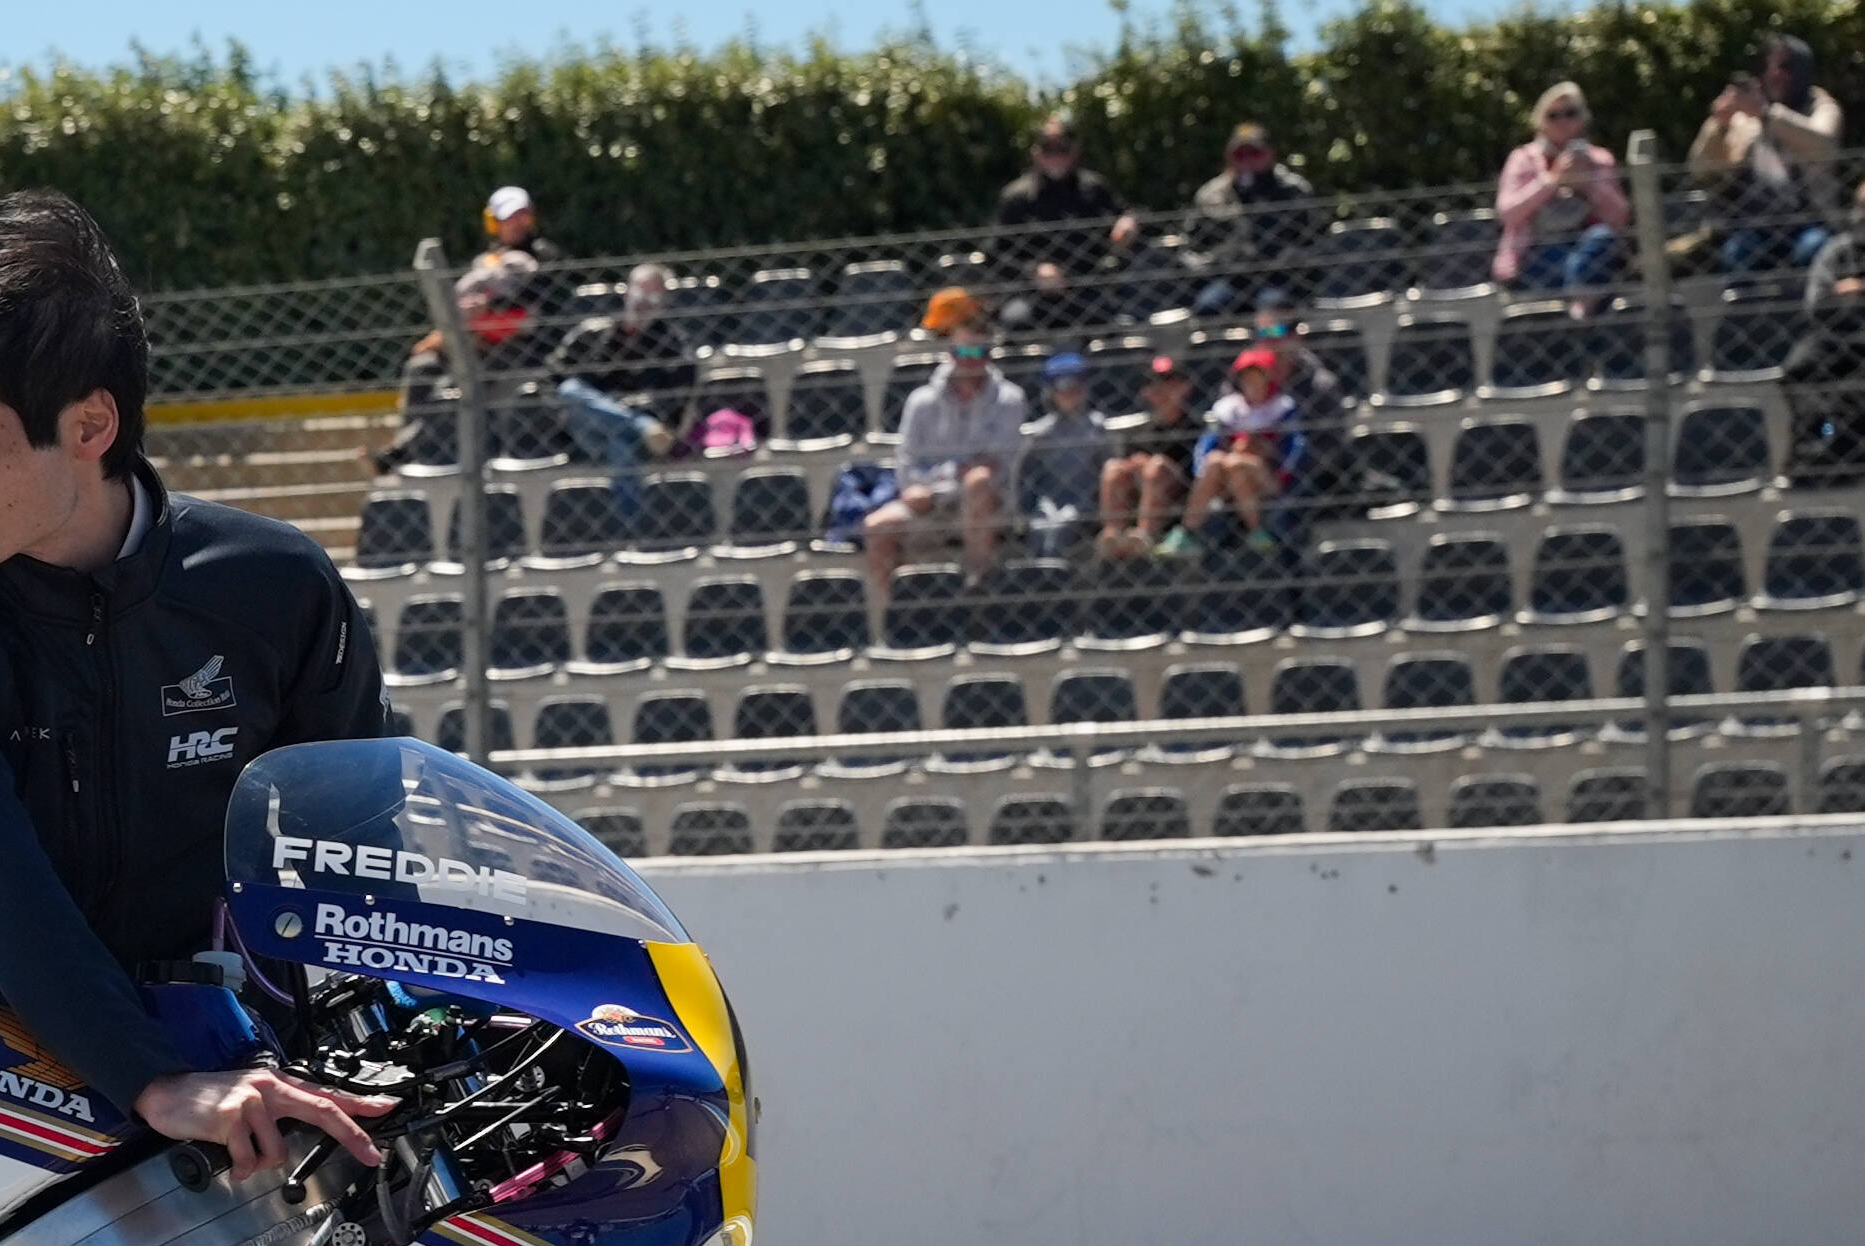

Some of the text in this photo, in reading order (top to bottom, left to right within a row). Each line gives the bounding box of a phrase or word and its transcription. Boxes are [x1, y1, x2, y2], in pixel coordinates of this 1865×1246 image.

[168, 727, 239, 763] HRC
[200, 752, 234, 764] RACING
[272, 836, 529, 906] FREDDIE
[315, 902, 514, 962] Rothmans
[323, 942, 506, 985] HONDA
[587, 1022, 677, 1039] Rothmans
